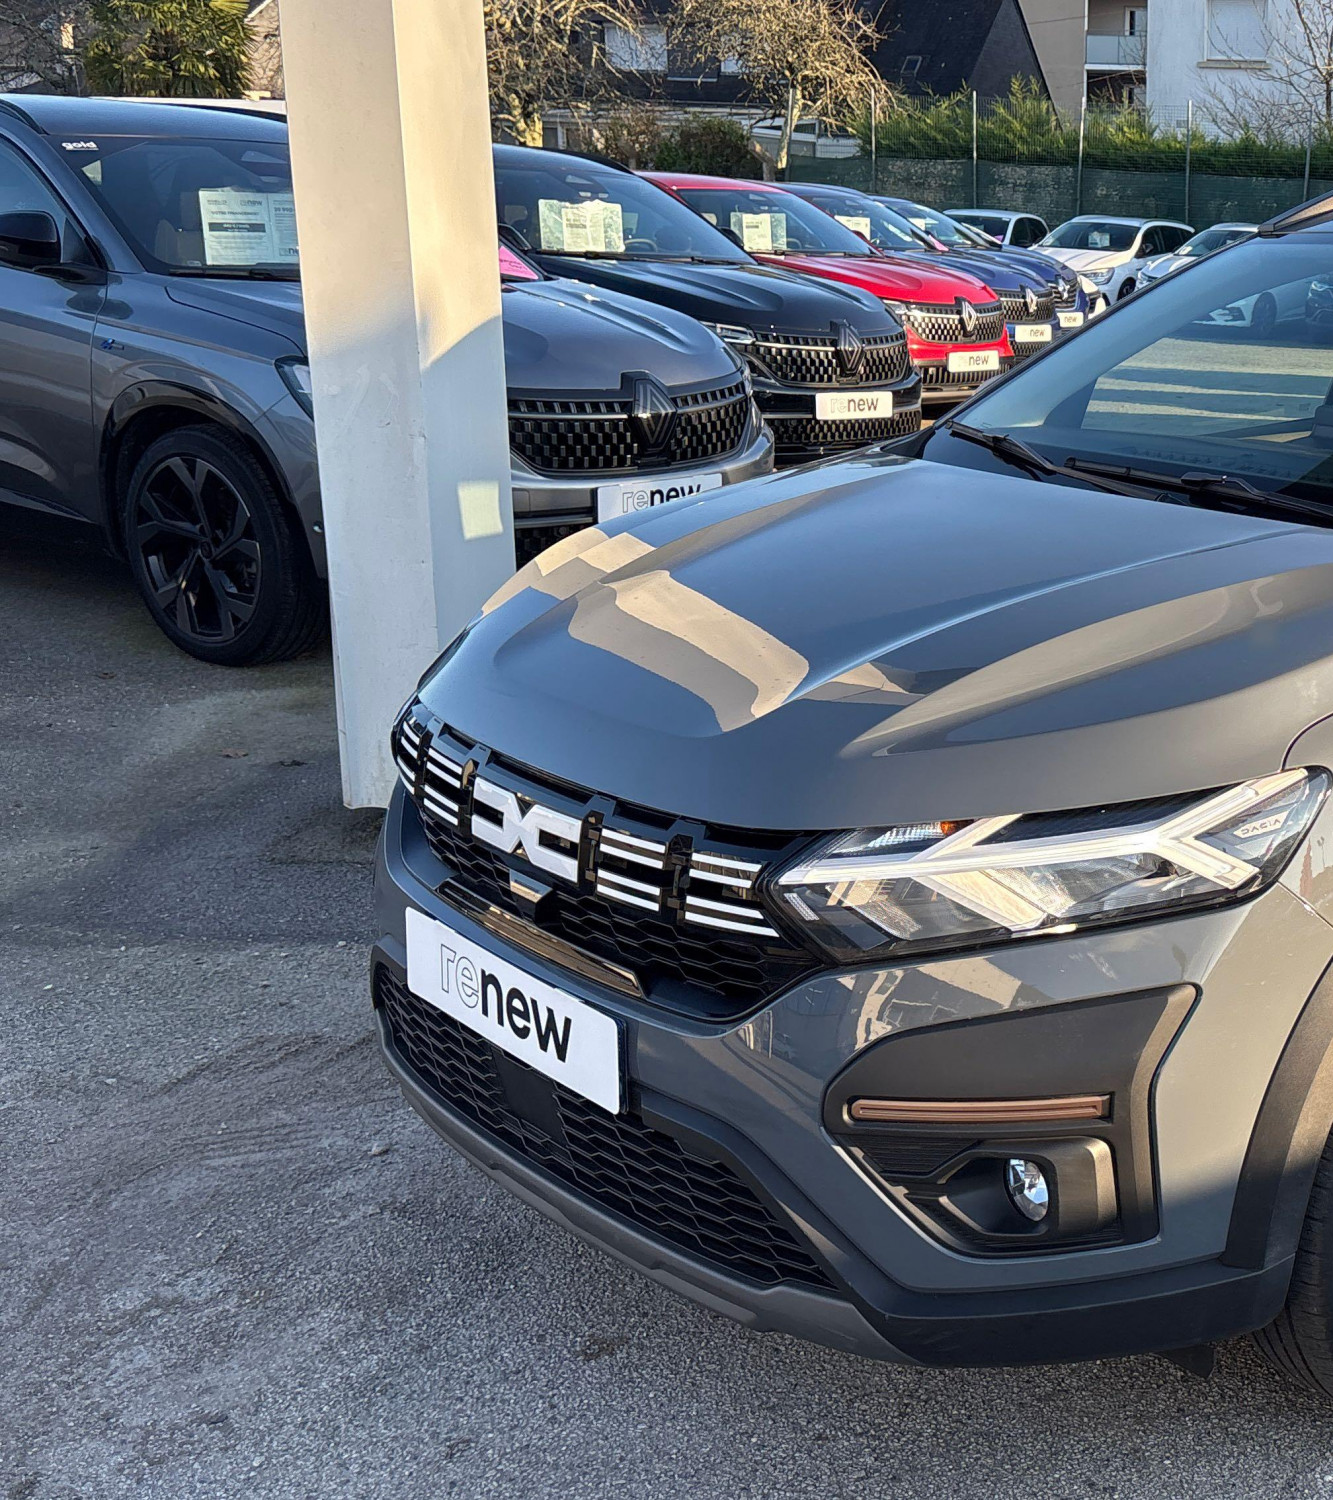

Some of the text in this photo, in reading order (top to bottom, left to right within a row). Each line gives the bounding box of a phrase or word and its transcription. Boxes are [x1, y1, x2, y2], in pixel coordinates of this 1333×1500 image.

[61, 141, 98, 150] gold
[1240, 818, 1281, 835] DACIA
[440, 943, 572, 1063] renew
